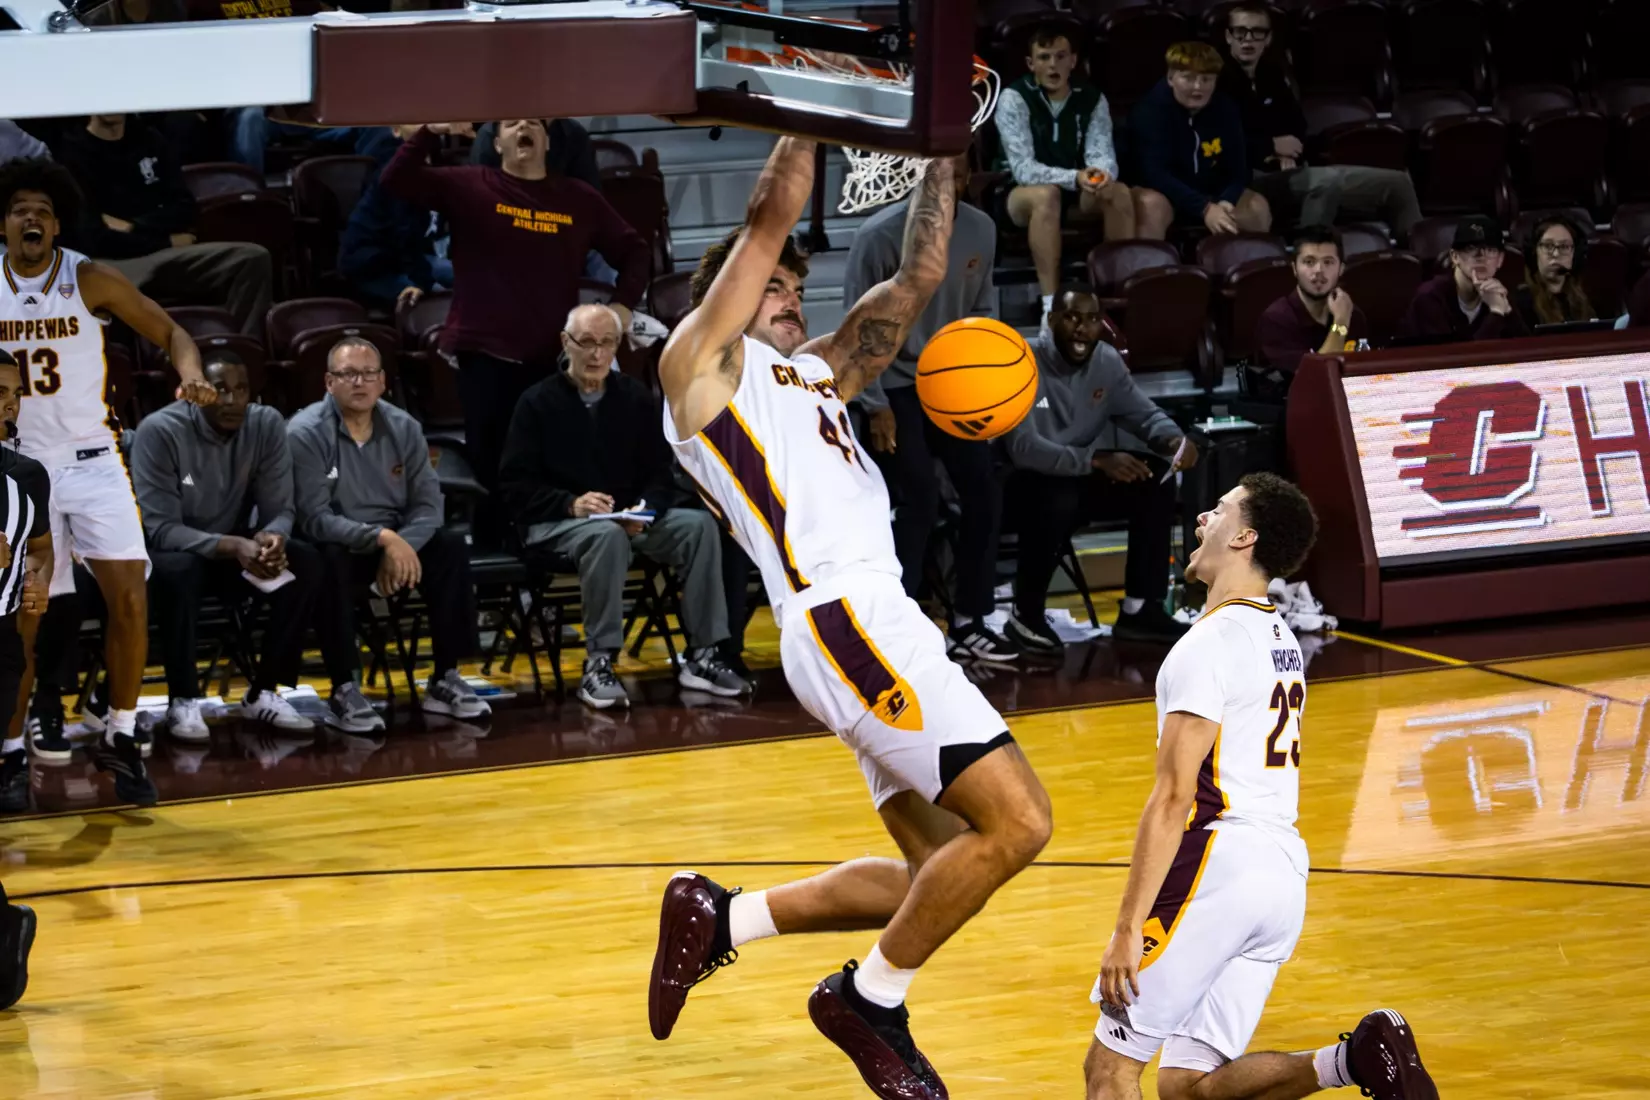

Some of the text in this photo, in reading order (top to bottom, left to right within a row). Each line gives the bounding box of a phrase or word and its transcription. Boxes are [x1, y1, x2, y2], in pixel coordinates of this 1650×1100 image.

[513, 218, 558, 233] ATHLETICS
[0, 316, 79, 341] HIPPEWAS
[13, 347, 62, 397] 13
[1264, 680, 1305, 768] 23
